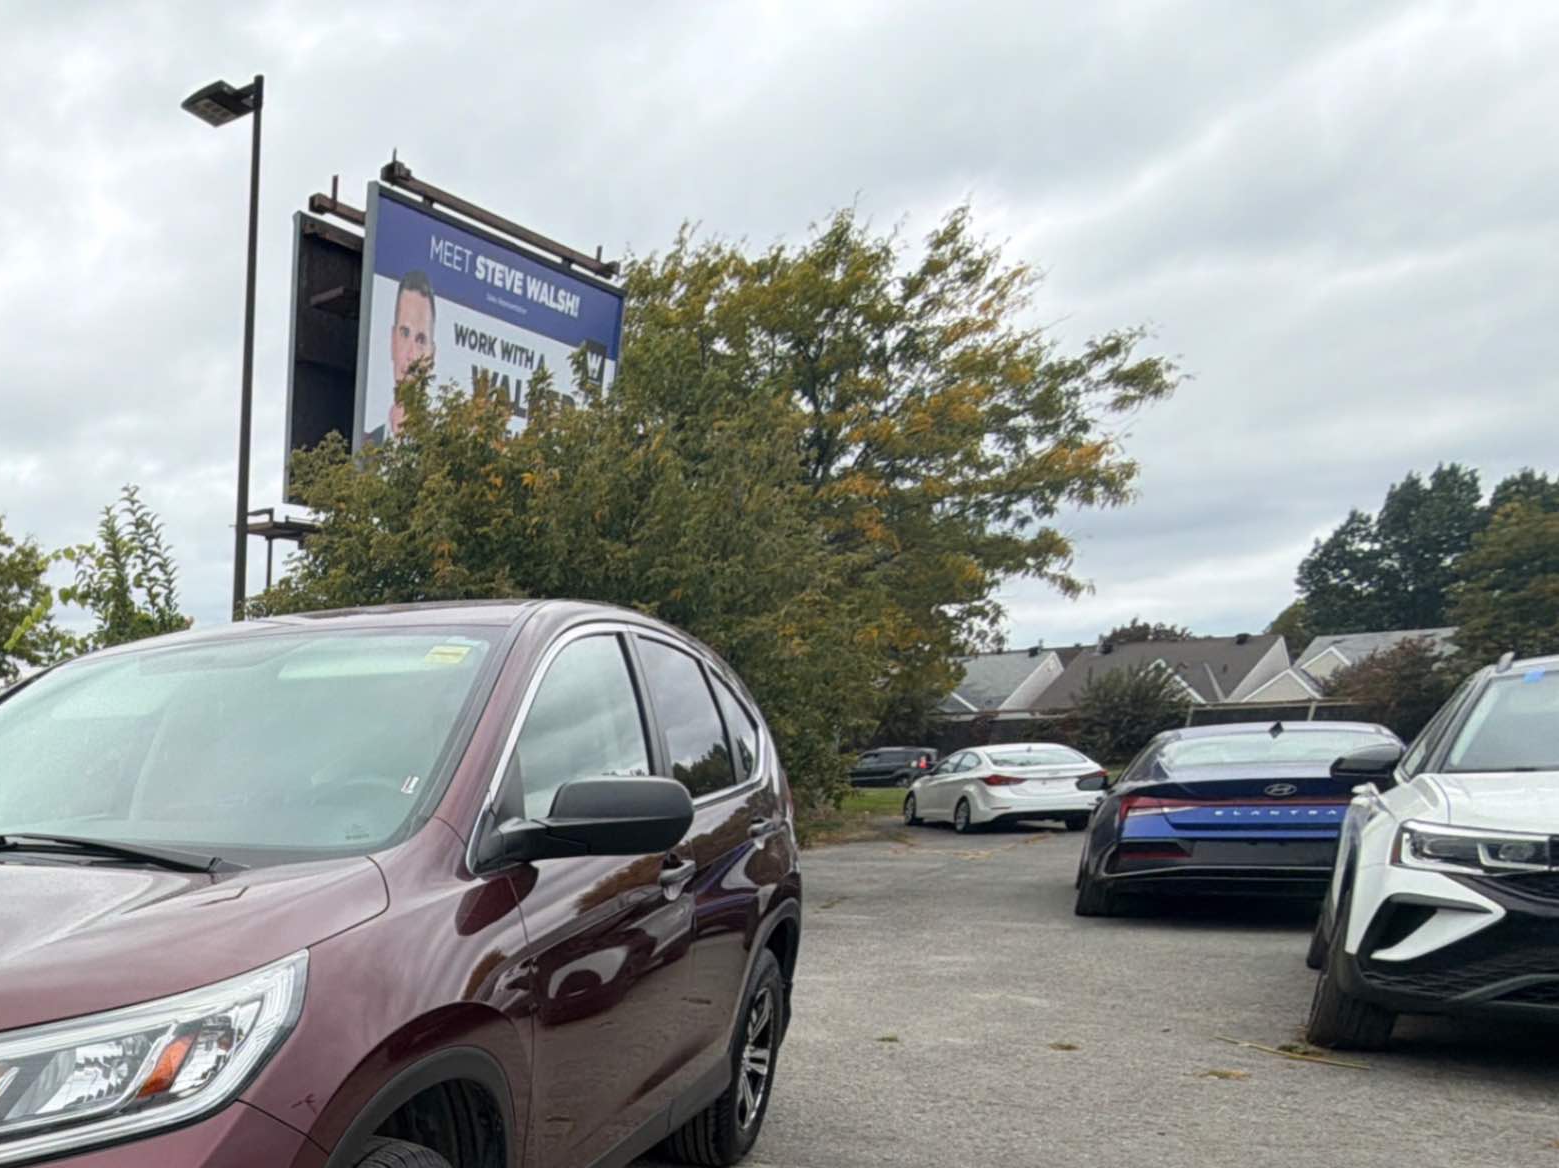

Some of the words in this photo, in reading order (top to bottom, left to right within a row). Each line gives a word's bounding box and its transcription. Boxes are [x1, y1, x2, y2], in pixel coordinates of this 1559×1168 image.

[430, 235, 473, 273] MEET
[475, 255, 524, 295] STEVE
[526, 275, 580, 318] WALSH!
[454, 322, 497, 358] WORK
[501, 340, 534, 370] WITH
